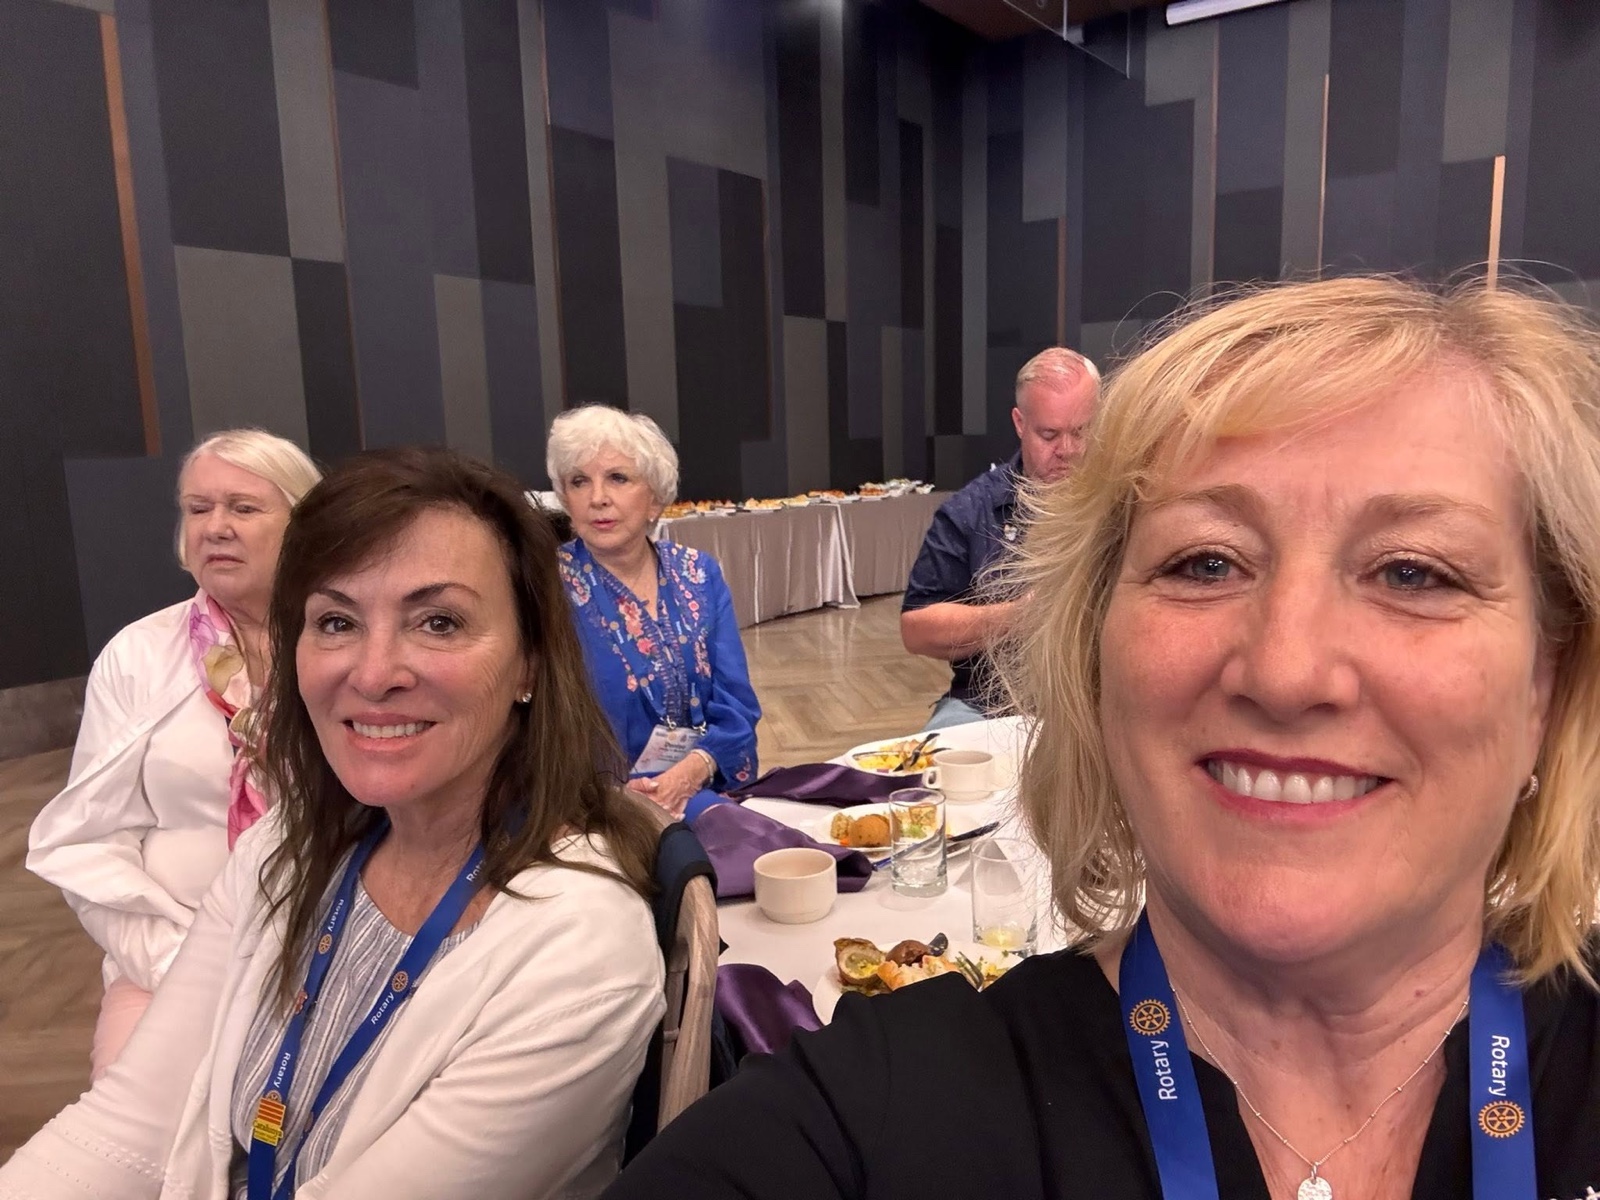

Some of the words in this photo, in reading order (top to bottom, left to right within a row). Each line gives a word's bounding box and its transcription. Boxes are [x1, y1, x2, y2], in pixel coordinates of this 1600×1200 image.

[327, 898, 345, 932] Rotary
[371, 992, 395, 1025] Rotary
[273, 1052, 291, 1089] Rotary
[1150, 1040, 1178, 1100] Rotary
[1488, 1034, 1511, 1097] Rotary
